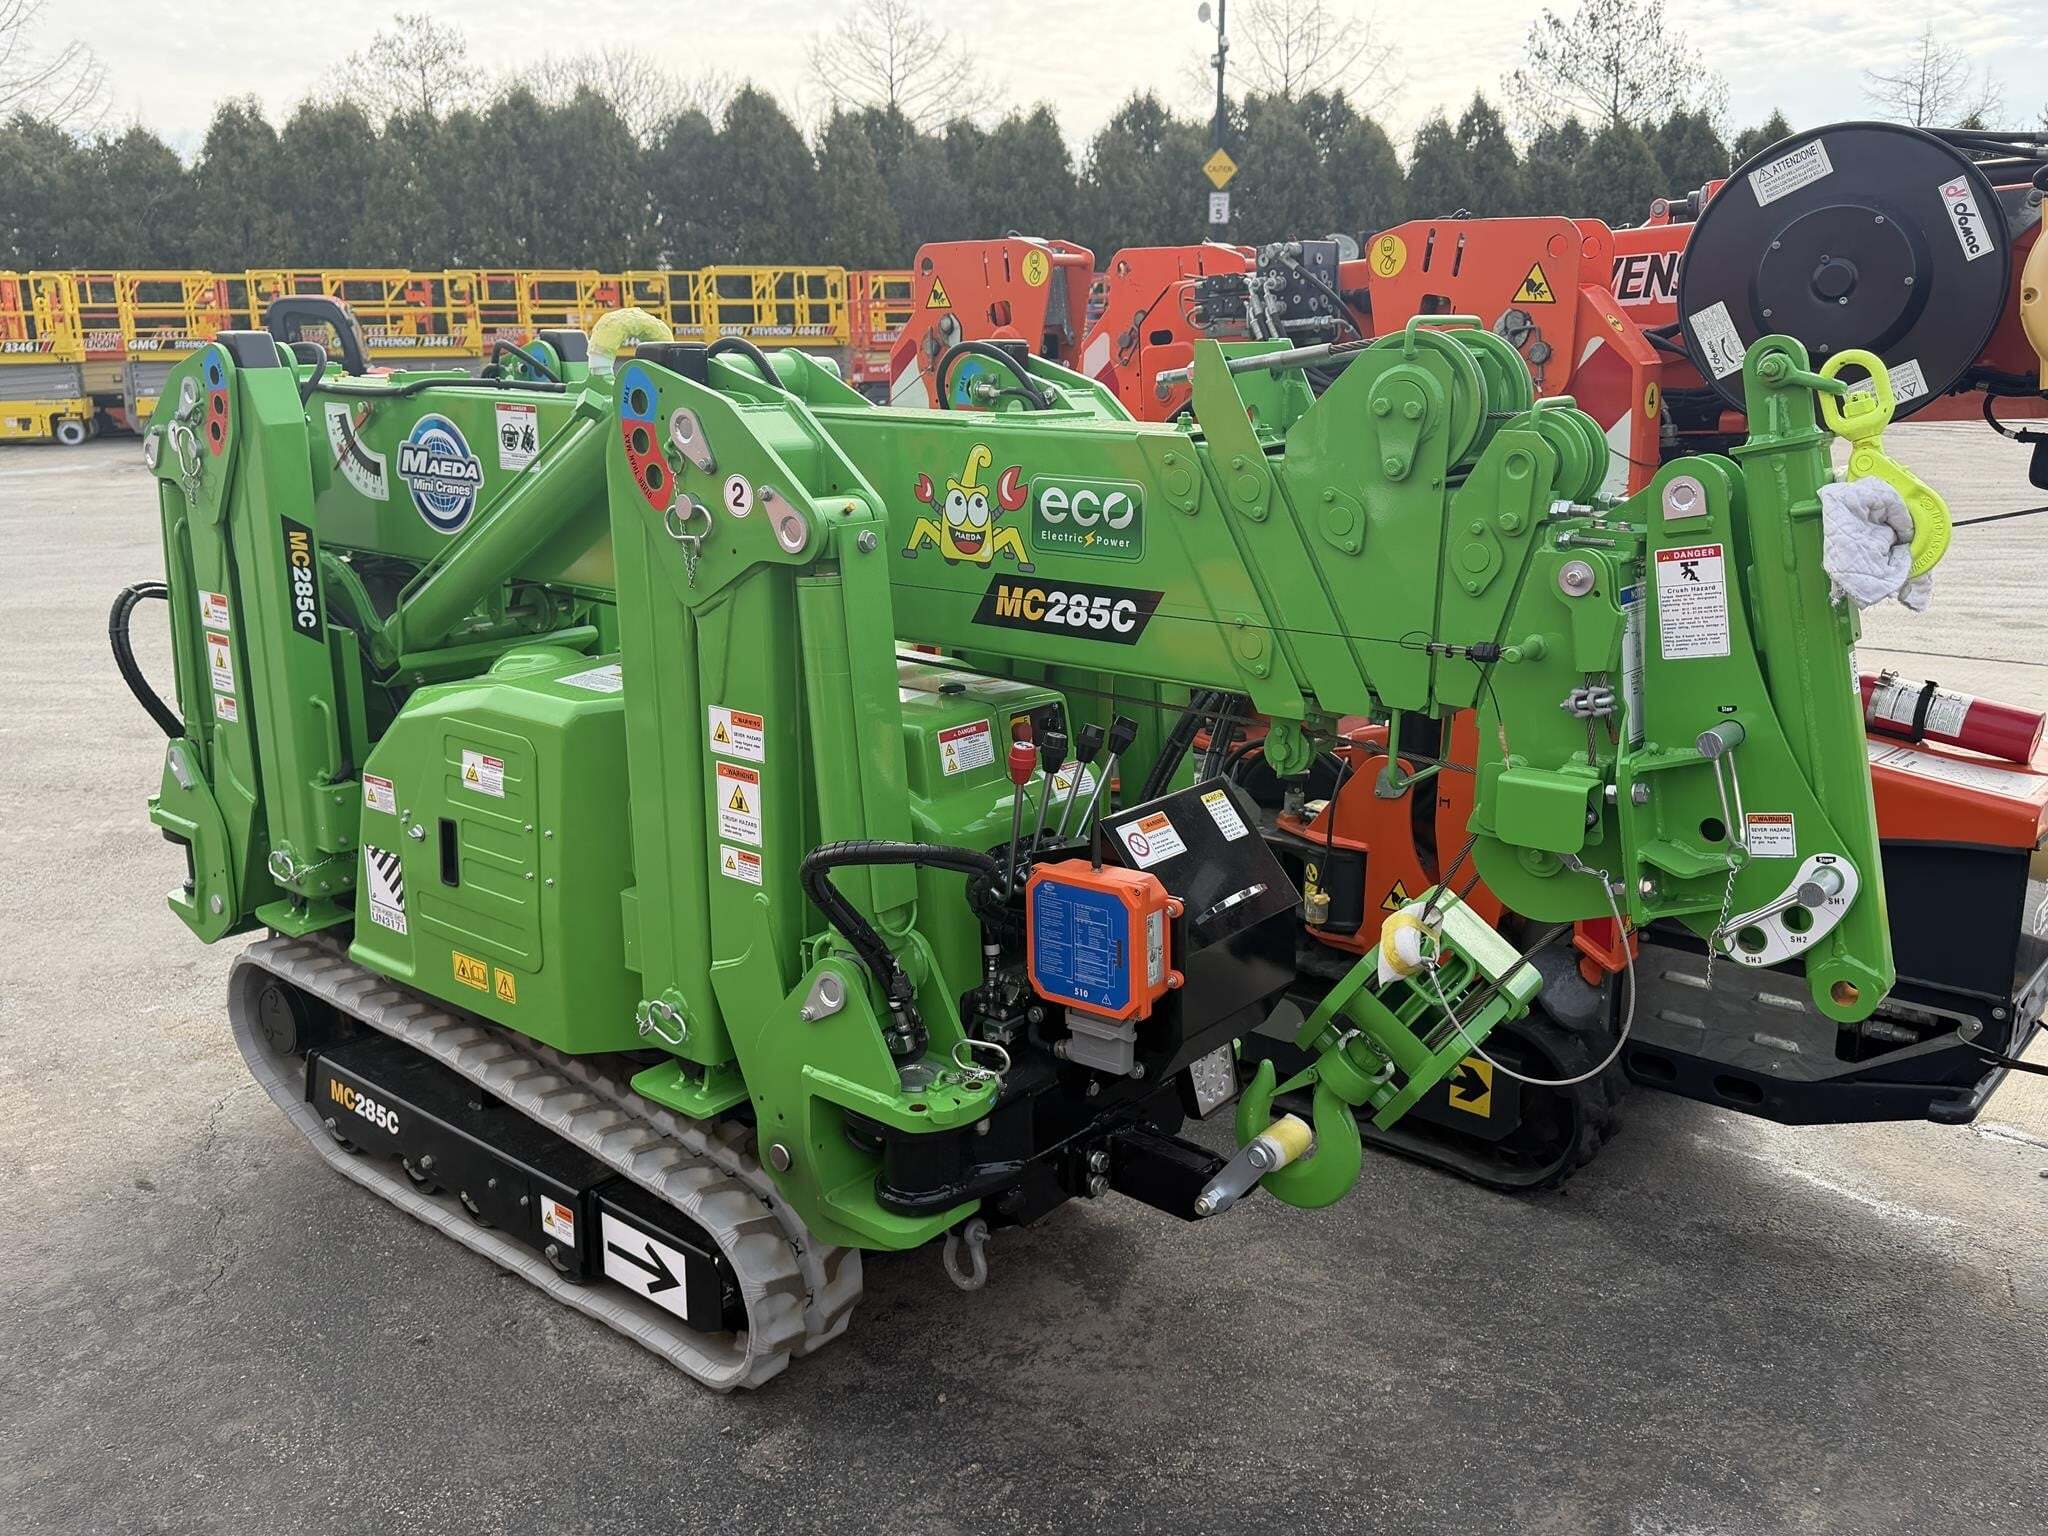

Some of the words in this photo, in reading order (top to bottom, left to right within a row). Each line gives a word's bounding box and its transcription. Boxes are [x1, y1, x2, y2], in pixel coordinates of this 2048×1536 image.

[1772, 145, 1818, 175] ATTENZIONE
[1215, 208, 1223, 220] 5
[1953, 202, 1980, 254] domac
[4, 341, 40, 352] 33461
[128, 339, 158, 350] GMG
[367, 336, 417, 347] STEVENSON
[623, 384, 631, 405] MAX
[1649, 388, 1655, 408] 4
[624, 433, 633, 450] MAX
[401, 448, 479, 481] MAEDA
[629, 454, 640, 476] THAN
[413, 477, 434, 492] Mini
[435, 479, 471, 496] Cranes
[638, 477, 653, 499] OTHER
[732, 483, 745, 508] 2
[1040, 486, 1134, 529] eco
[954, 530, 982, 541] MAEDA
[1041, 530, 1083, 544] Electric
[1096, 536, 1130, 548] Power
[1673, 547, 1715, 560] DANGER
[288, 530, 317, 628] MC285C
[1667, 586, 1689, 595] Crush
[995, 584, 1137, 633] MC285C
[957, 725, 977, 736] DANGER
[727, 767, 754, 781] WARNING
[738, 818, 758, 829] HAZARD
[1818, 856, 1834, 864] Stow
[1828, 897, 1845, 905] SH1
[372, 910, 406, 933] UN3171
[1790, 935, 1808, 943] SH2
[1745, 956, 1762, 964] SH3
[330, 1078, 400, 1135] MC285C
